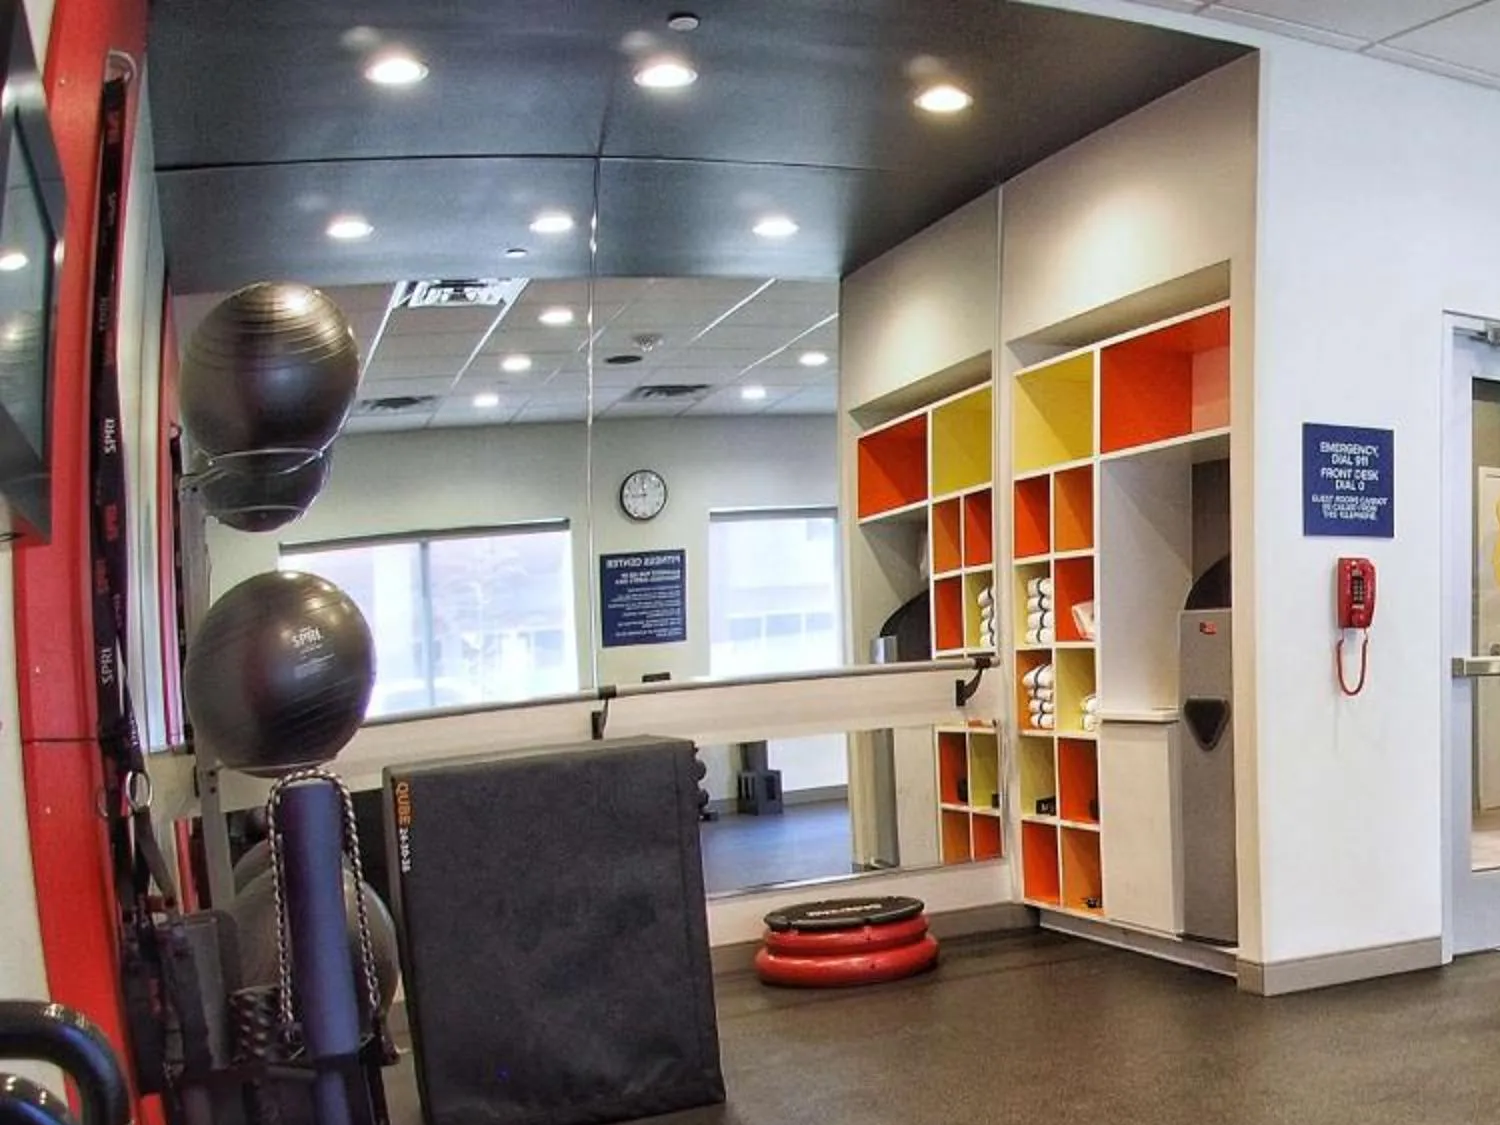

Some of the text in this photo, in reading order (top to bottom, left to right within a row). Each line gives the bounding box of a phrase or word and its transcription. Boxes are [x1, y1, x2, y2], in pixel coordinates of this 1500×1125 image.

[1331, 453, 1369, 467] DIAL 911
[1320, 467, 1379, 481] FRONT DESK
[1335, 479, 1356, 491] DIAL
[100, 647, 113, 684] SPRI
[395, 782, 411, 826] QUBE
